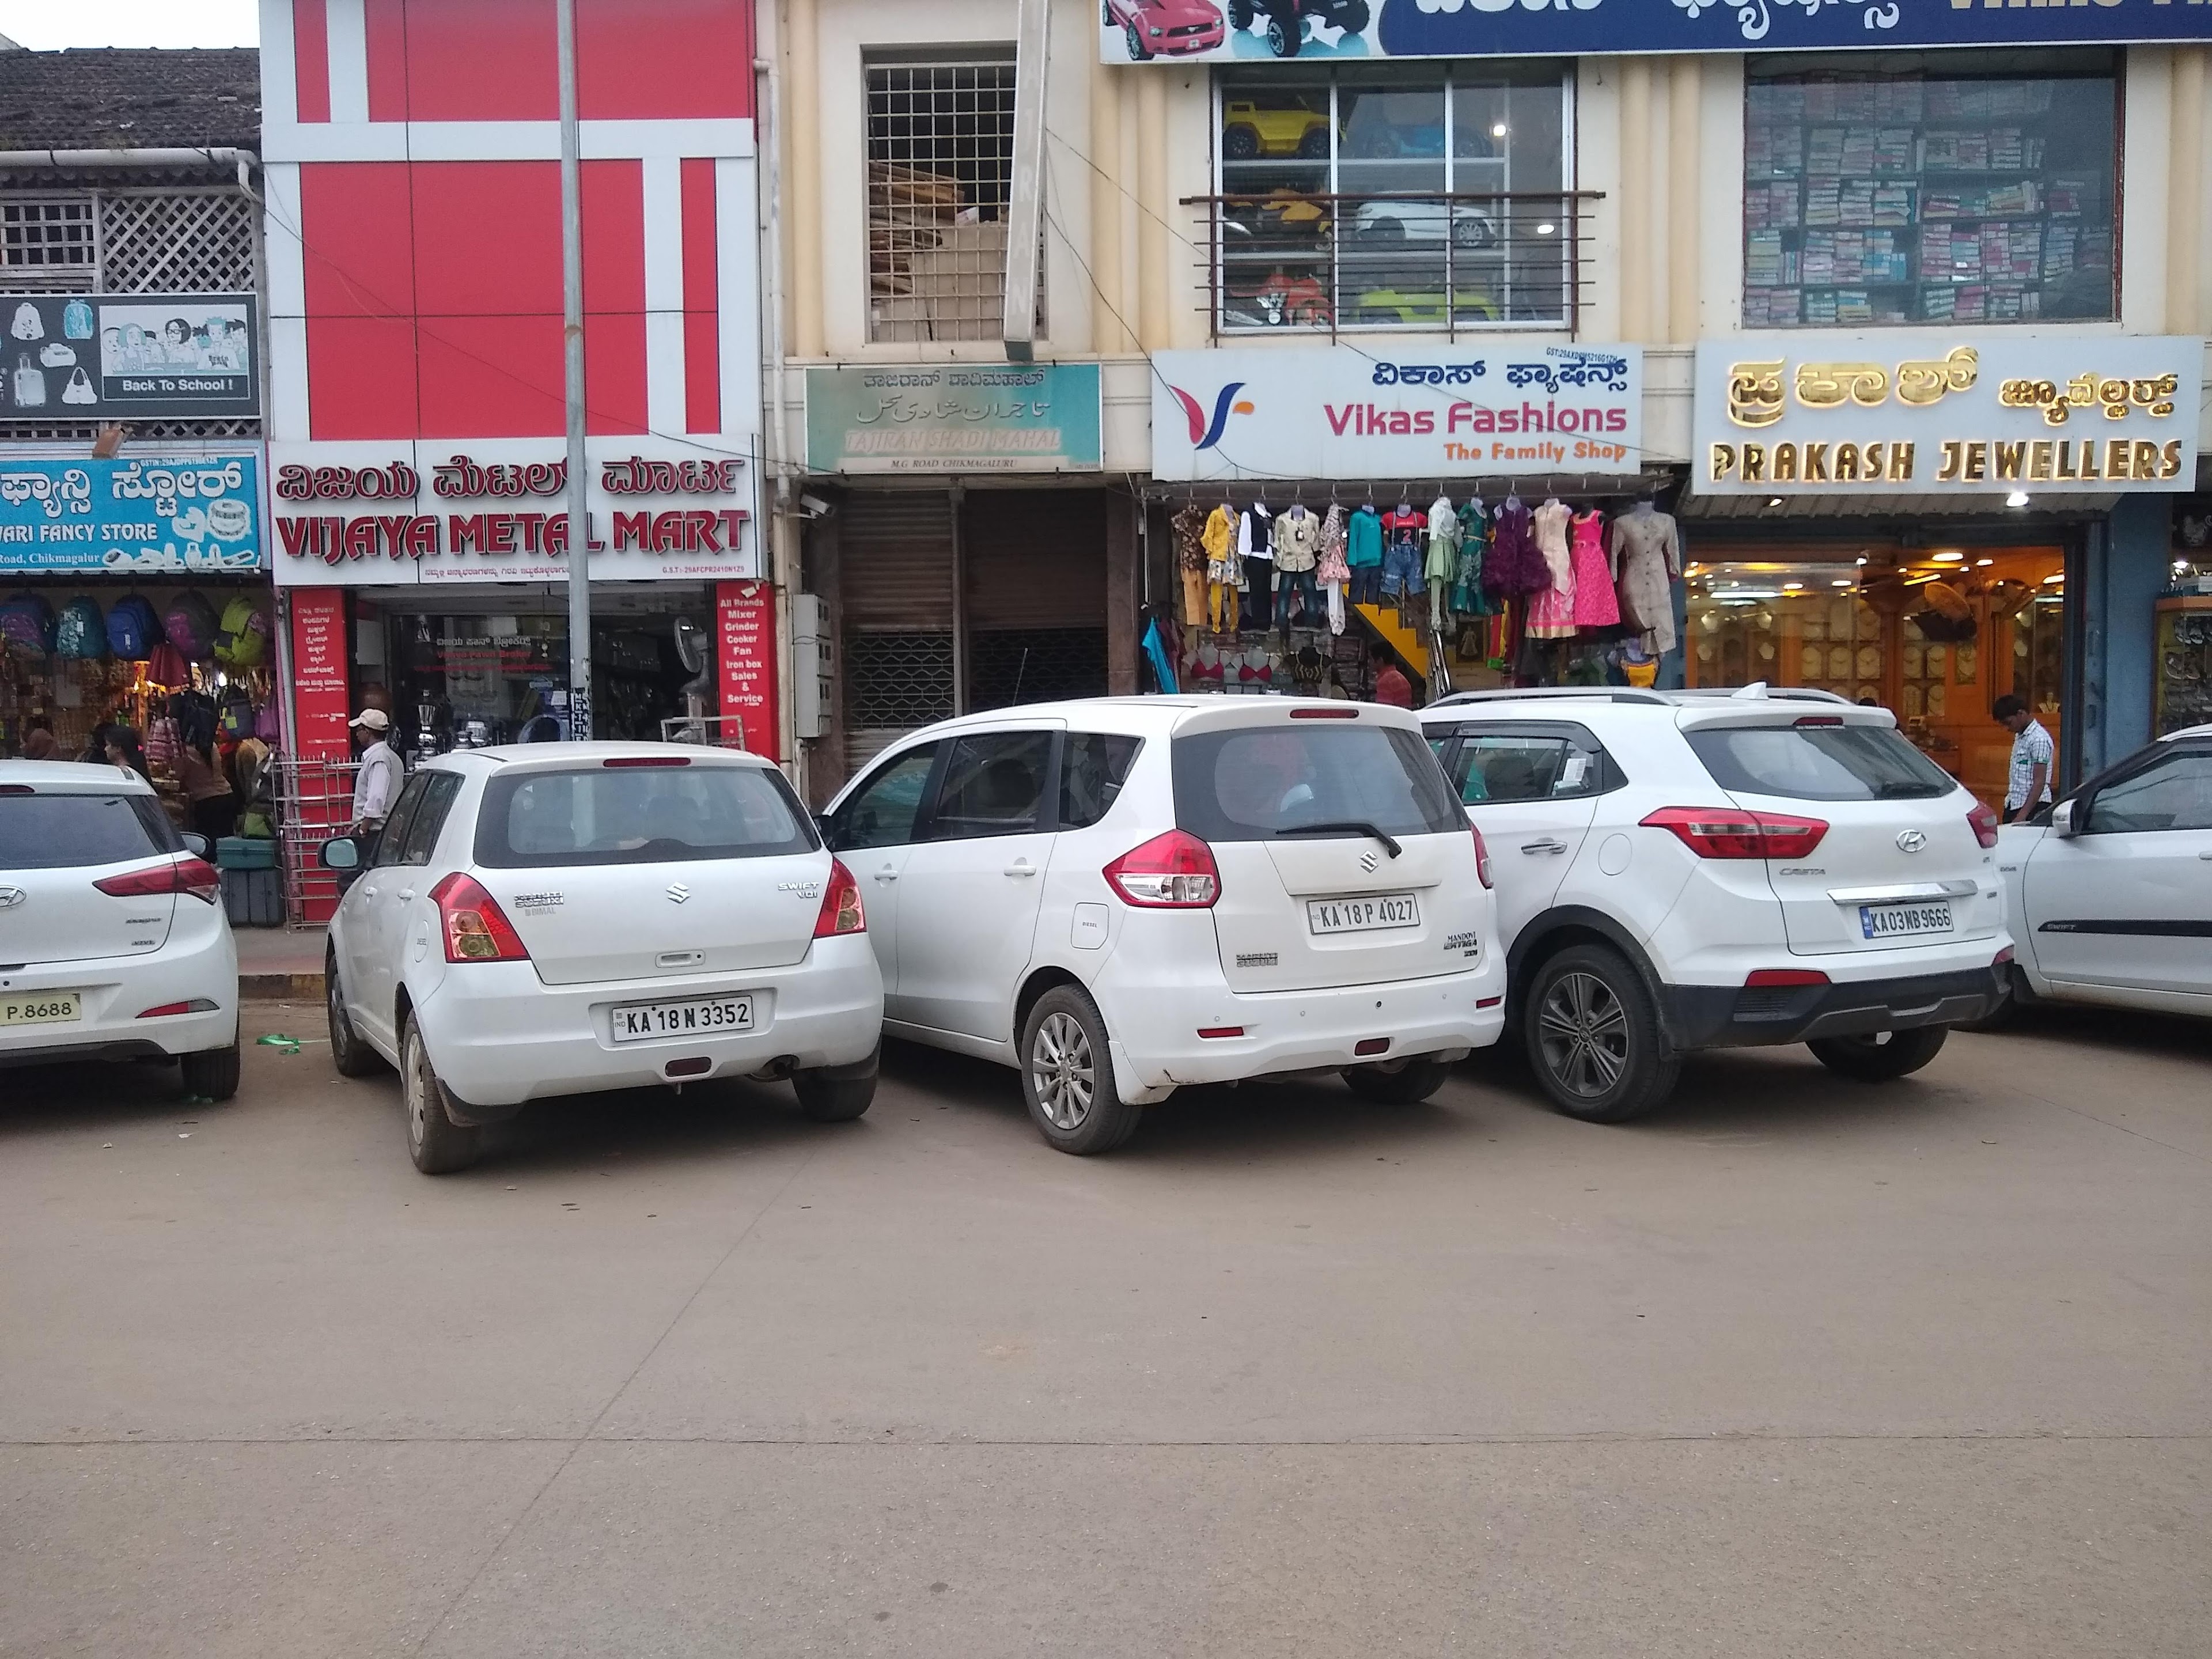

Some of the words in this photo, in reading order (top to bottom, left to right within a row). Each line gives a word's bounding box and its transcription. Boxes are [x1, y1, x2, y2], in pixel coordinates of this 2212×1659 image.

[1372, 359, 1486, 385] ವಿಕಾಸ್
[123, 380, 156, 391] Back
[158, 380, 175, 391] To
[178, 379, 225, 391] School
[1727, 346, 1979, 427] ಪ್ರಕಾಶ್
[1324, 403, 1434, 436] Vikas
[1448, 400, 1626, 434] Fashions
[846, 430, 925, 452] TAJIRAN
[929, 430, 987, 450] SHADI
[991, 429, 1060, 449] MAHAL
[1444, 443, 1482, 460] The
[1491, 441, 1565, 464] Family
[1573, 440, 1626, 463] Shop
[943, 460, 1016, 468] CHIKMAGALURU
[1711, 441, 1915, 482] PRAKASH
[1936, 439, 2186, 482] JEWELLERS
[276, 460, 420, 500] ವಿಜಯ
[112, 461, 242, 517] ಸ್ಟೋರ್
[0, 525, 33, 543] ARI
[40, 523, 95, 543] FANCY
[101, 522, 157, 541] STORE
[275, 514, 440, 566] VIJAYA
[448, 512, 605, 558] METAL
[612, 509, 750, 555] MART
[1402, 529, 1412, 542] 2
[29, 552, 100, 565] Chikmagalur
[721, 599, 734, 608] All
[734, 599, 764, 607] Brands
[728, 611, 756, 619] Mixer
[725, 623, 759, 631] Grinder
[727, 635, 757, 643] Cooker
[734, 647, 752, 655] Fan
[726, 660, 744, 669] Iron
[745, 660, 762, 668] box
[732, 672, 757, 681] Sales
[741, 682, 749, 691] &
[728, 694, 763, 703] Service
[778, 881, 819, 891] SWIFT
[515, 897, 564, 908] SUZUKI
[1320, 906, 1341, 927] KA
[1344, 904, 1362, 925] 18
[1364, 903, 1373, 924] P
[1379, 899, 1412, 922] 4027
[1870, 908, 1951, 933] KA03NB9666
[1447, 931, 1476, 942] MANDOVI
[7, 1002, 72, 1020] P.8688
[627, 1012, 652, 1033] KA
[658, 1010, 679, 1030] 18
[684, 1008, 696, 1028] N
[700, 1003, 749, 1026] 3352
